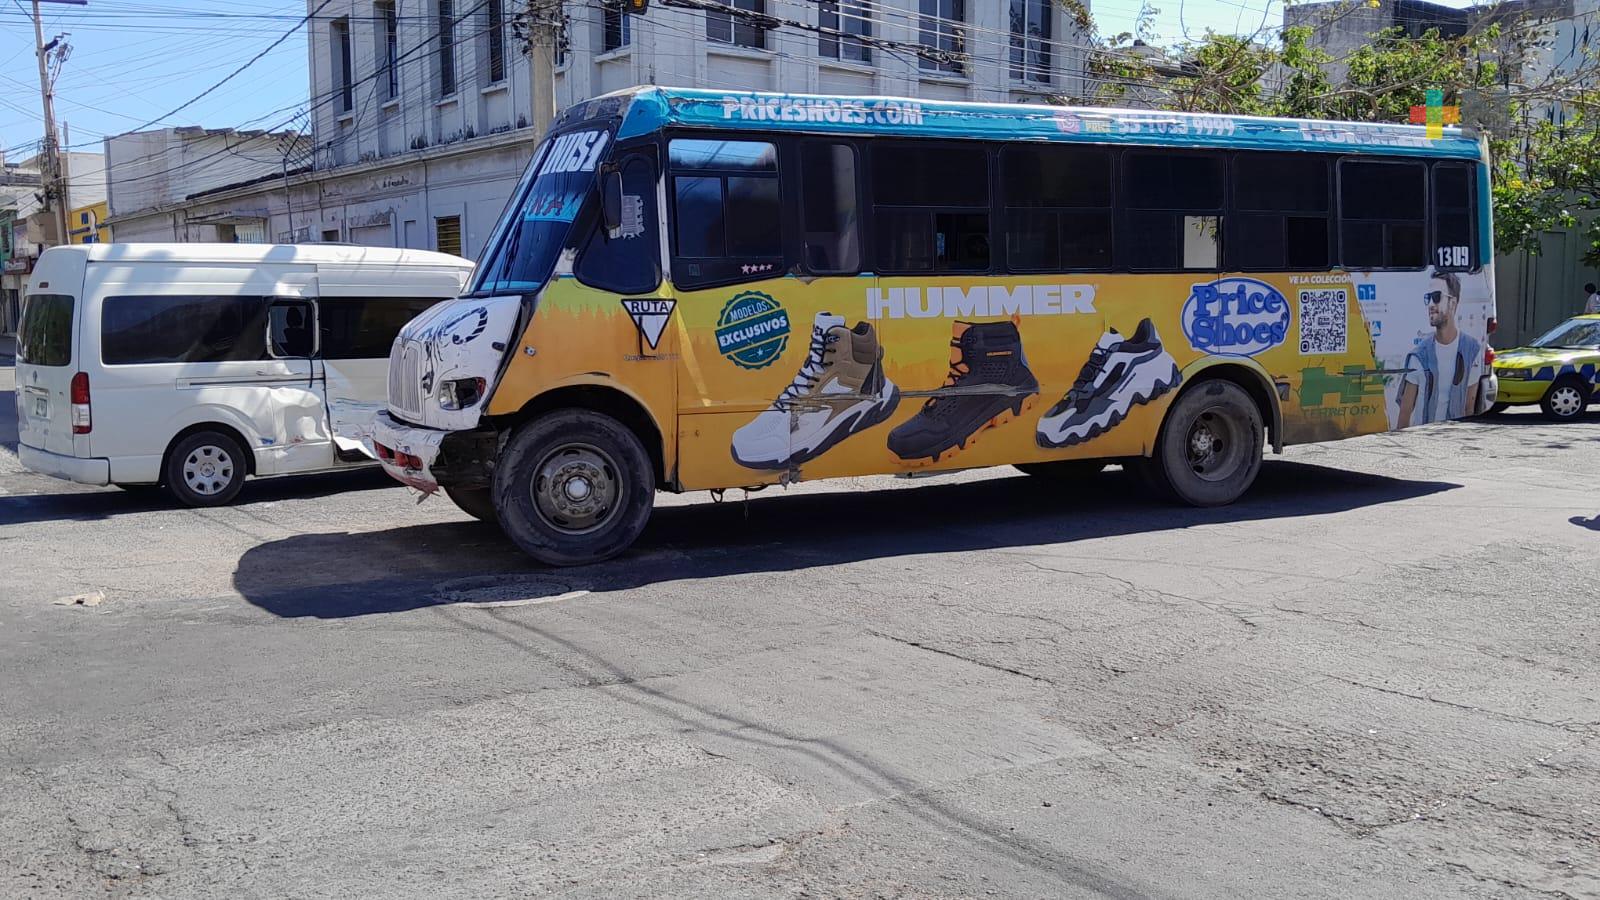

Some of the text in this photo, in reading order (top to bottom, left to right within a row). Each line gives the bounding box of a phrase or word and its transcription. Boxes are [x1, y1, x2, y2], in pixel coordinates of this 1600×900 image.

[722, 96, 923, 125] PRICESHOES.COM
[1192, 116, 1235, 136] 9999
[1437, 246, 1469, 266] 1309
[1300, 275, 1309, 284] LA
[631, 301, 668, 313] RUTA
[866, 284, 1096, 319] HUMMER
[1193, 284, 1282, 317] Price
[718, 315, 788, 347] EXCLUSIVOS
[1191, 314, 1284, 347] Shoes
